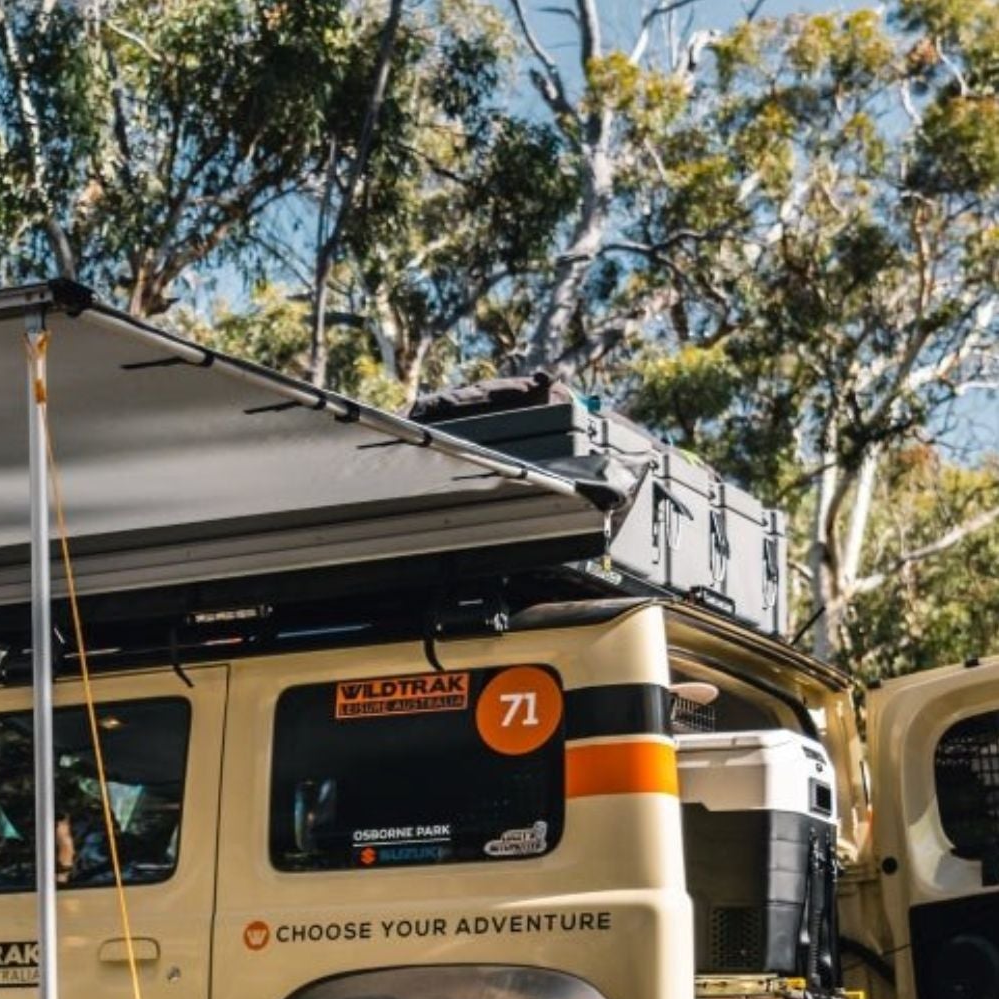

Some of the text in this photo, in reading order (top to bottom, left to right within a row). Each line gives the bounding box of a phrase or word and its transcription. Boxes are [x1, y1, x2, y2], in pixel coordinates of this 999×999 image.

[341, 675, 466, 700] WILDTRAK
[500, 692, 539, 727] 71
[352, 824, 451, 842] OSBORNE PARK
[276, 912, 611, 943] CHOOSE YOUR ADVENTURE
